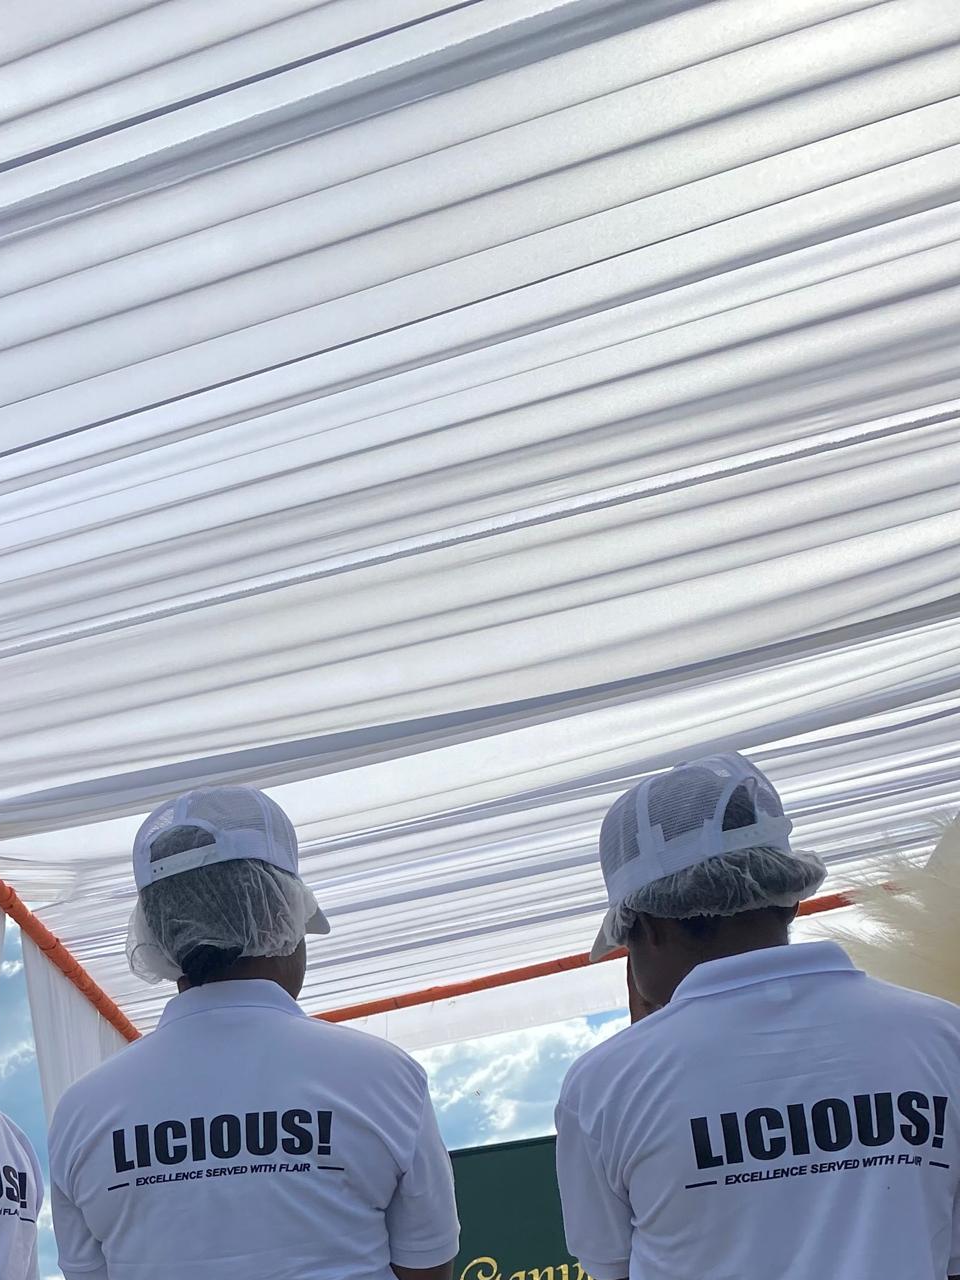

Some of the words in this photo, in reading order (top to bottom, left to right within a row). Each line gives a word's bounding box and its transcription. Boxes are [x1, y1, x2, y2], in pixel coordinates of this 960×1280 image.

[112, 1109, 333, 1173] LICIOUS!
[690, 1090, 948, 1170] LICIOUS!
[135, 1169, 204, 1187] EXCELLENCE
[205, 1165, 248, 1178] SERVED
[250, 1163, 277, 1174] WITH
[278, 1162, 312, 1173] FLAIR
[724, 1166, 808, 1185] EXCELLENCE
[810, 1159, 860, 1174] SERVED
[862, 1154, 895, 1168] WITH
[896, 1153, 923, 1167] FLIR
